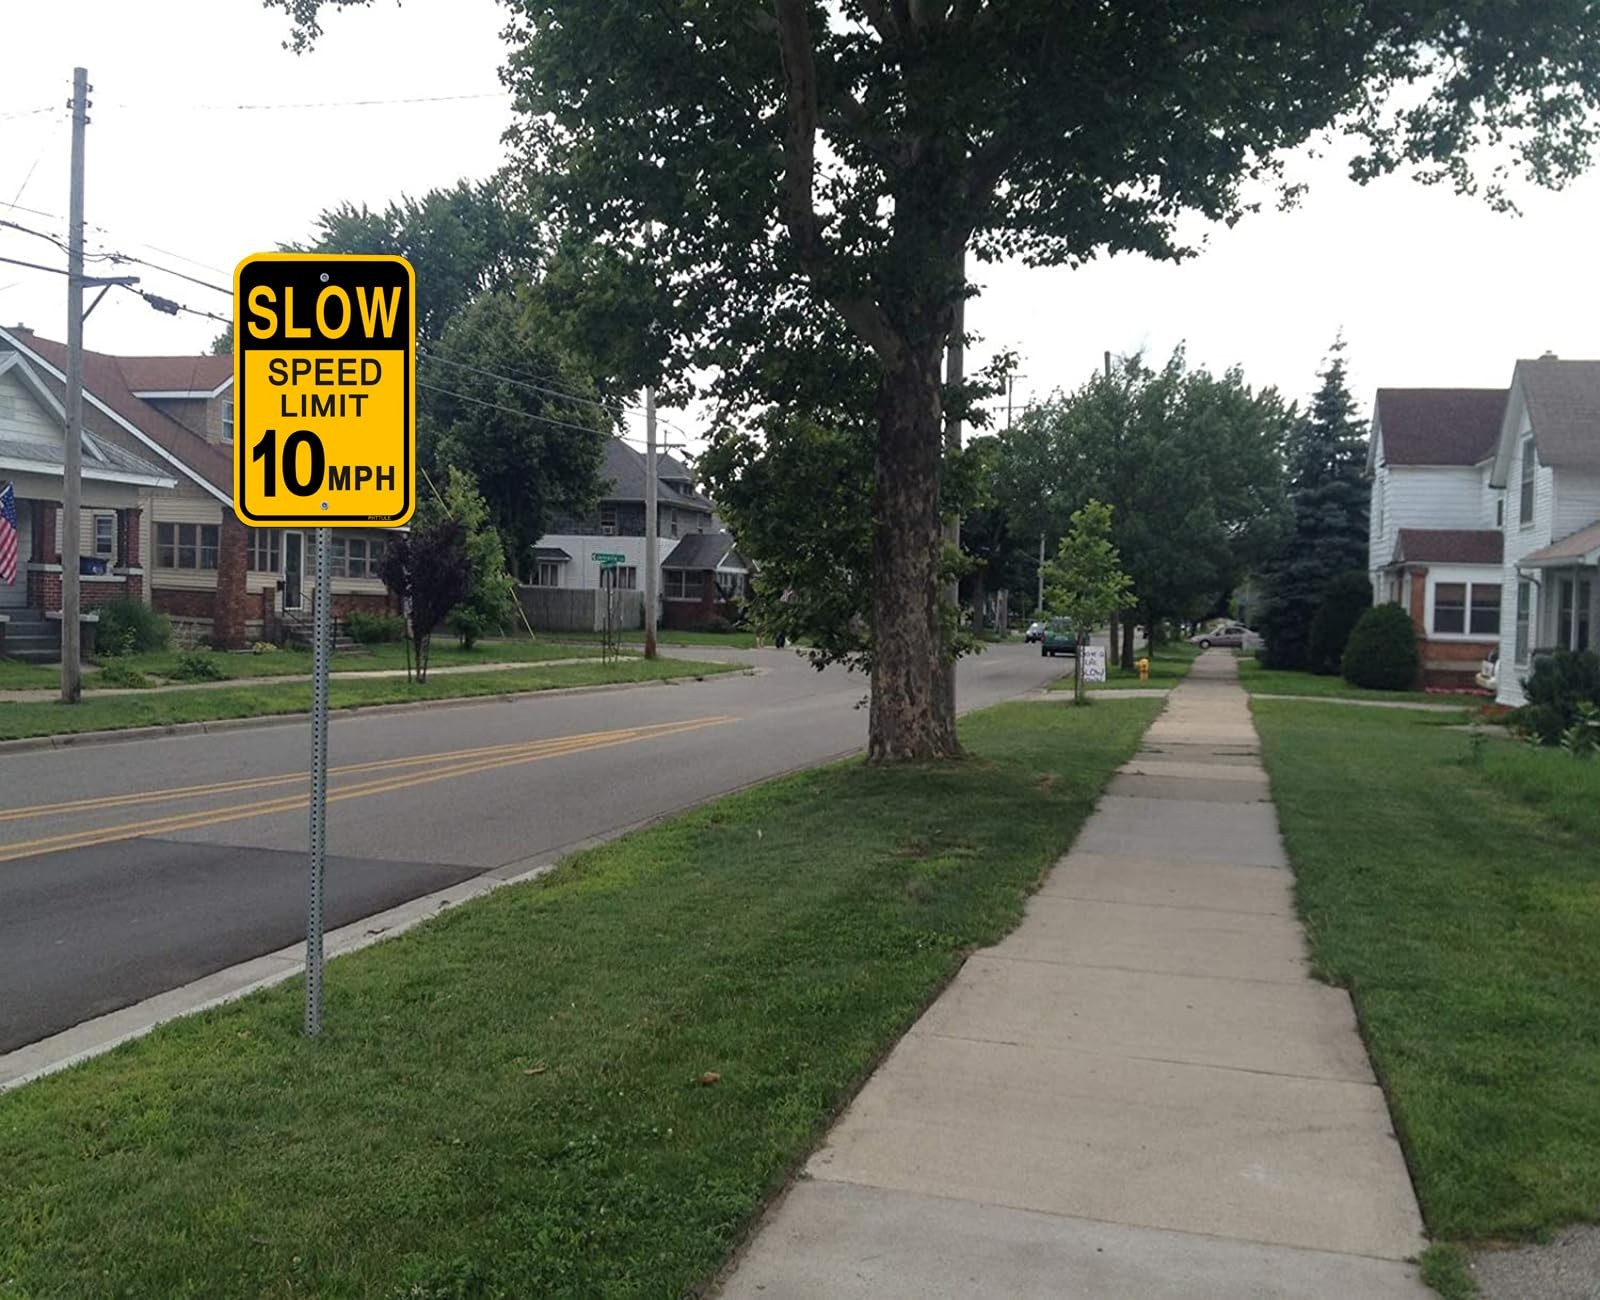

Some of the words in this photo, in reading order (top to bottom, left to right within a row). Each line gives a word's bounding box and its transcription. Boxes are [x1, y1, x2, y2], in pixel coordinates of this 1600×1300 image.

[247, 285, 402, 340] SLOW
[268, 357, 382, 387] SPEED
[281, 394, 369, 418] LIMIT
[252, 429, 326, 498] 10
[328, 465, 395, 491] MPH
